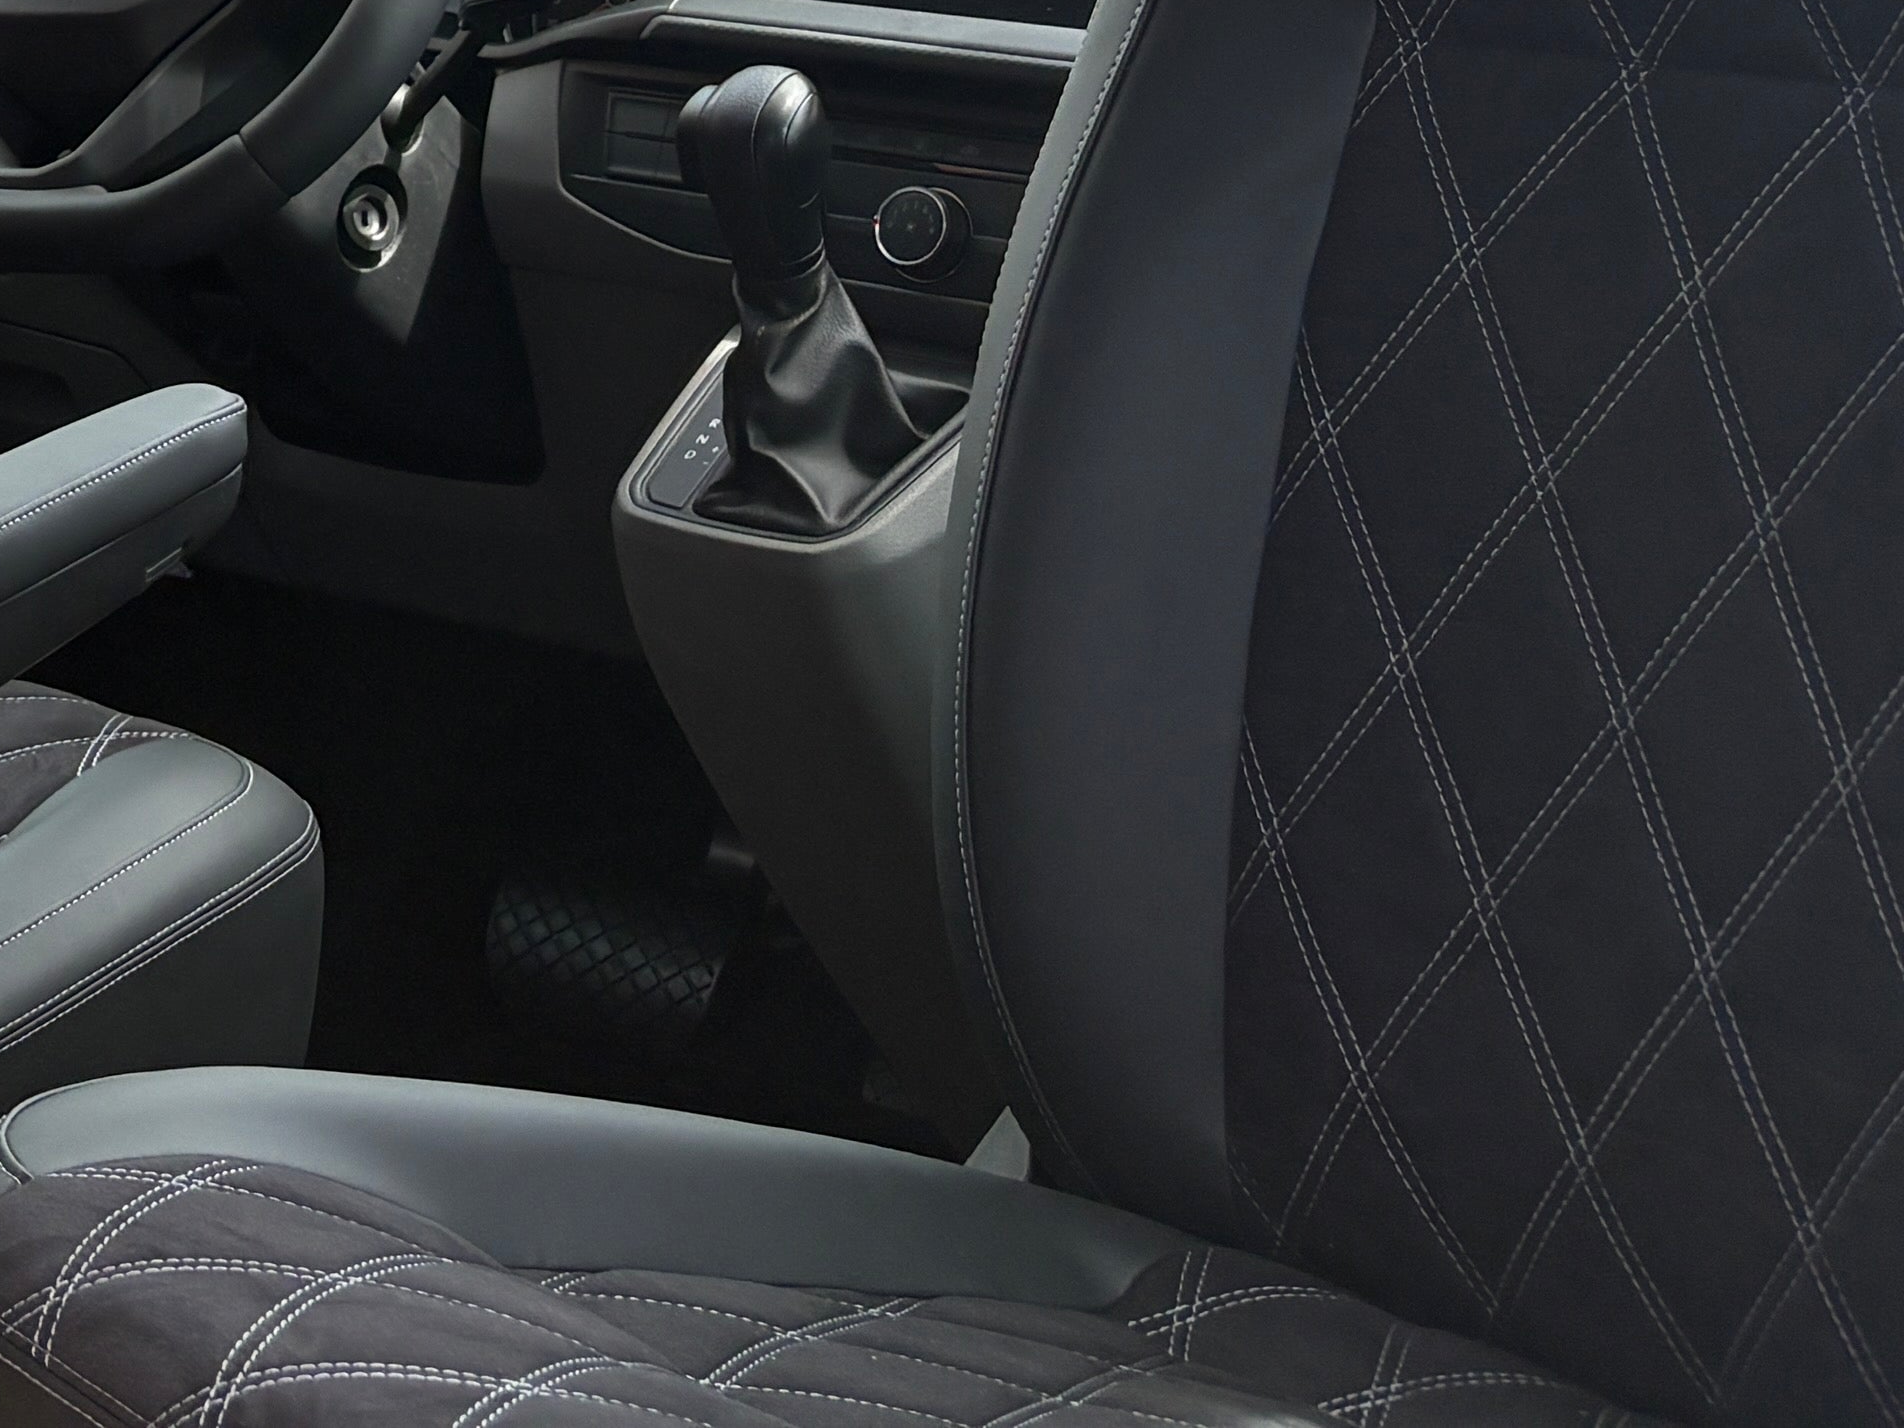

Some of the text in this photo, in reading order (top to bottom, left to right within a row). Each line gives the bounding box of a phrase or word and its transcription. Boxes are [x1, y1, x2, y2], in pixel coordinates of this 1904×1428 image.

[709, 418, 721, 428] R
[695, 433, 710, 444] N
[684, 450, 697, 459] D
